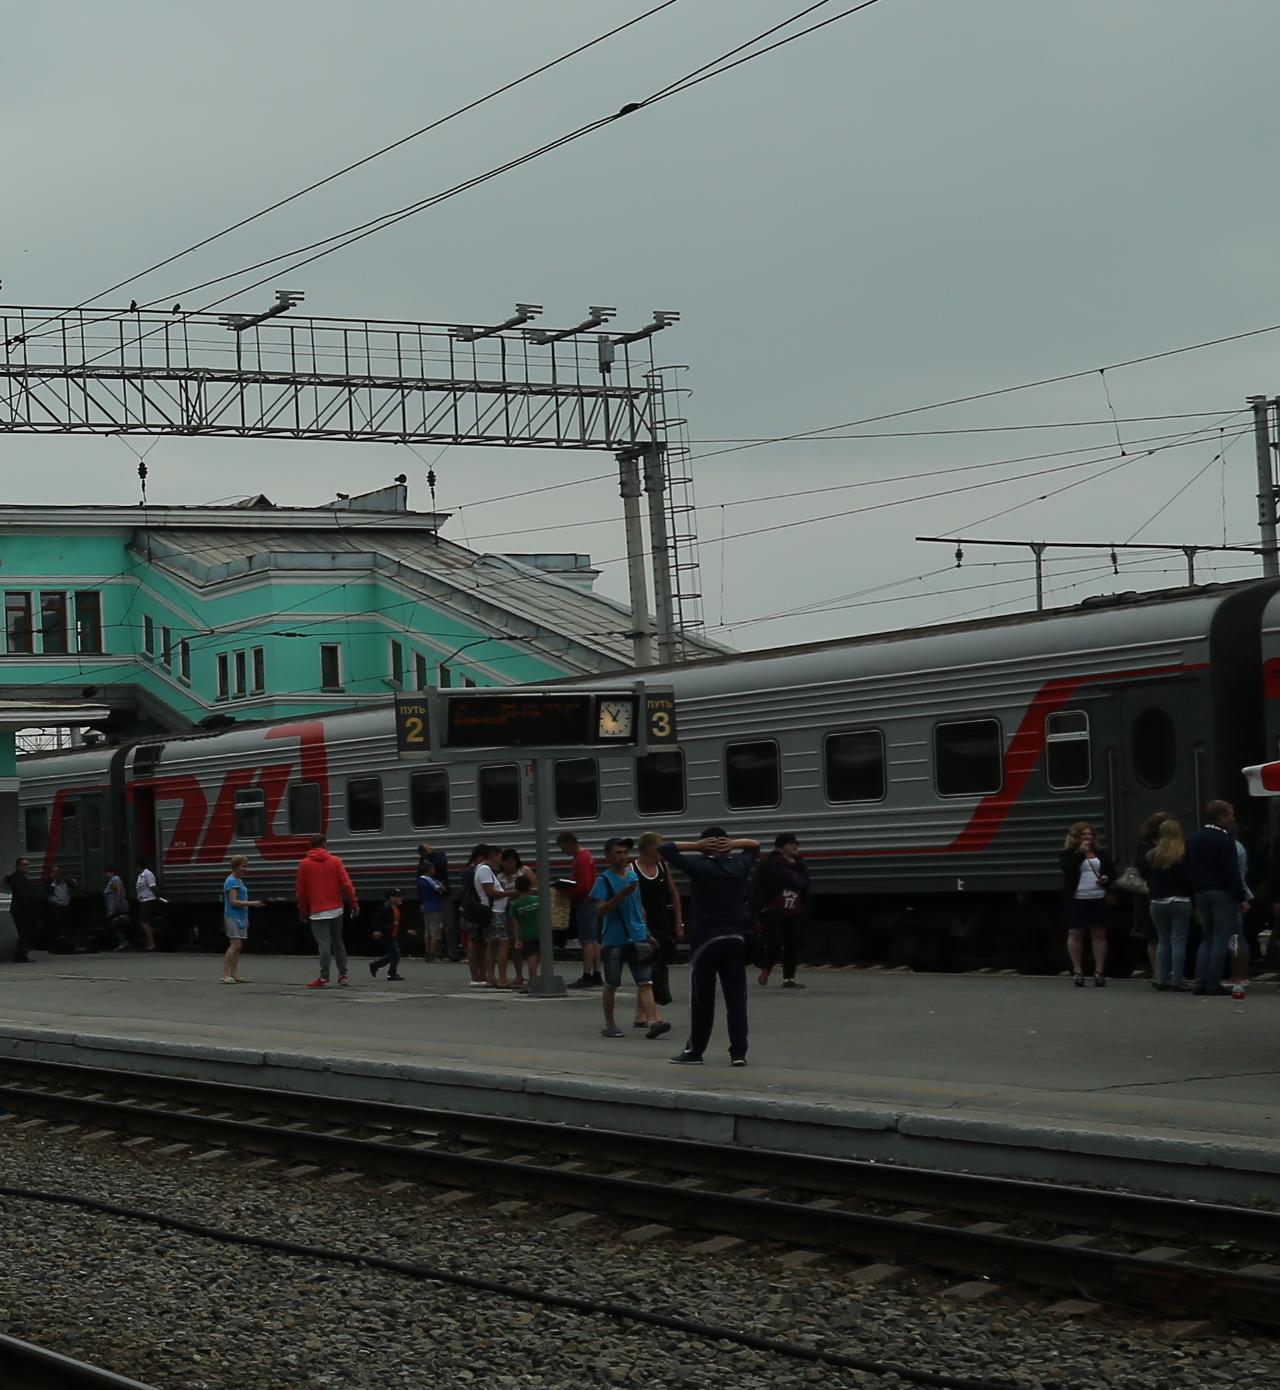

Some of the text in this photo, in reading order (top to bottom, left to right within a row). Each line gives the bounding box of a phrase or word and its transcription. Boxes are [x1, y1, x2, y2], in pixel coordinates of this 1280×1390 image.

[399, 705, 426, 715] ПУТЬ
[405, 717, 425, 743] 2
[651, 711, 671, 737] 3
